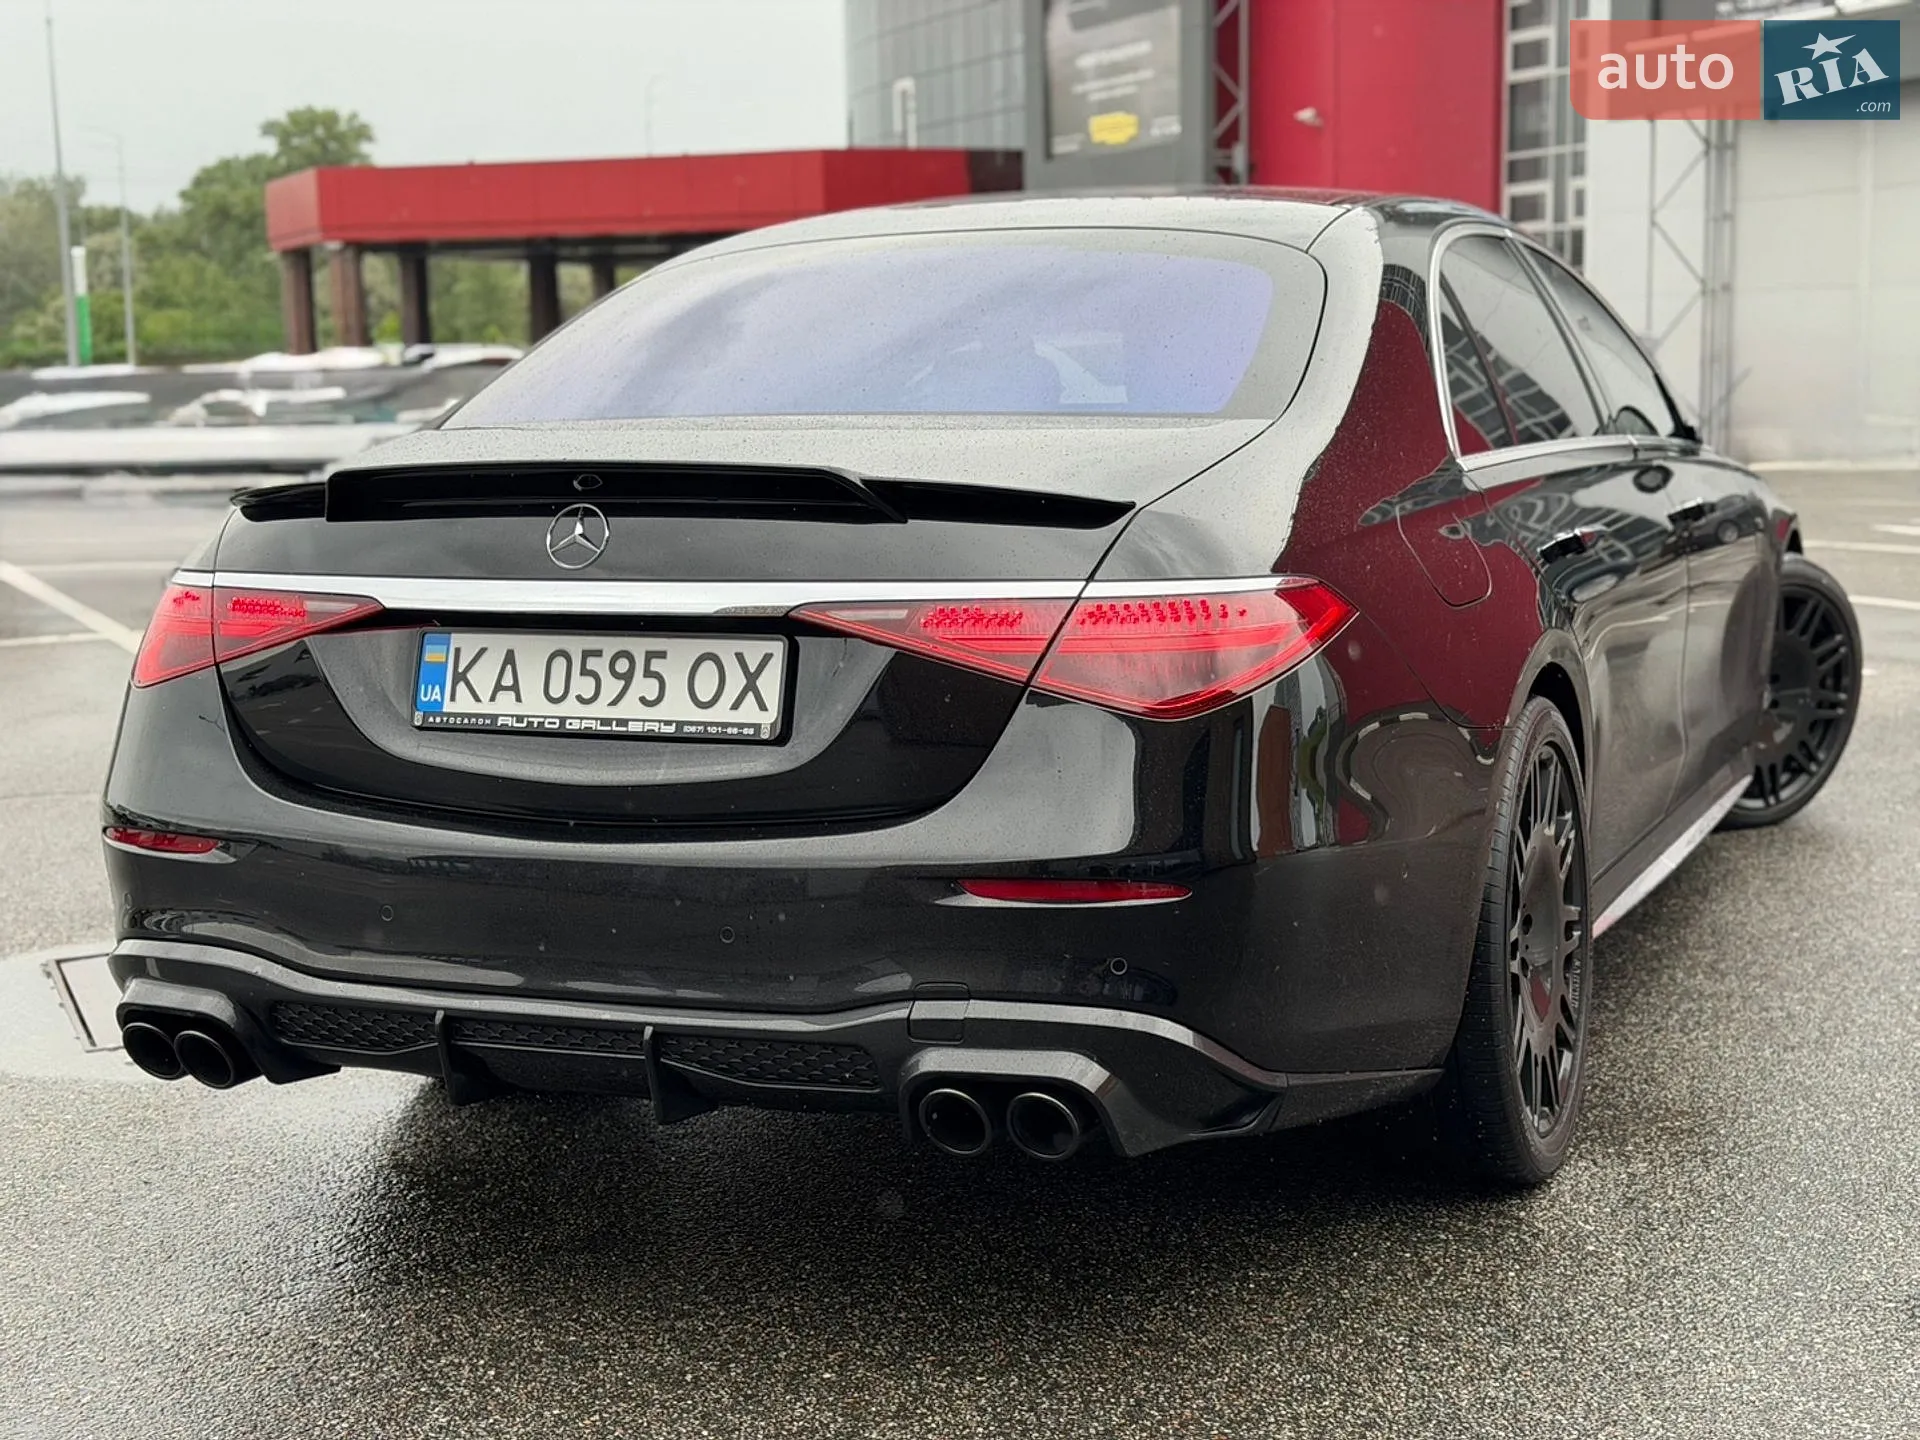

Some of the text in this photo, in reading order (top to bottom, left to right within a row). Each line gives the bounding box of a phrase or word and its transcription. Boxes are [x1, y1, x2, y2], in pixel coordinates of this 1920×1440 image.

[450, 647, 774, 712] KA 0595 OX
[420, 684, 441, 702] UA
[497, 716, 559, 729] AUTO
[565, 718, 676, 734] GALLERY
